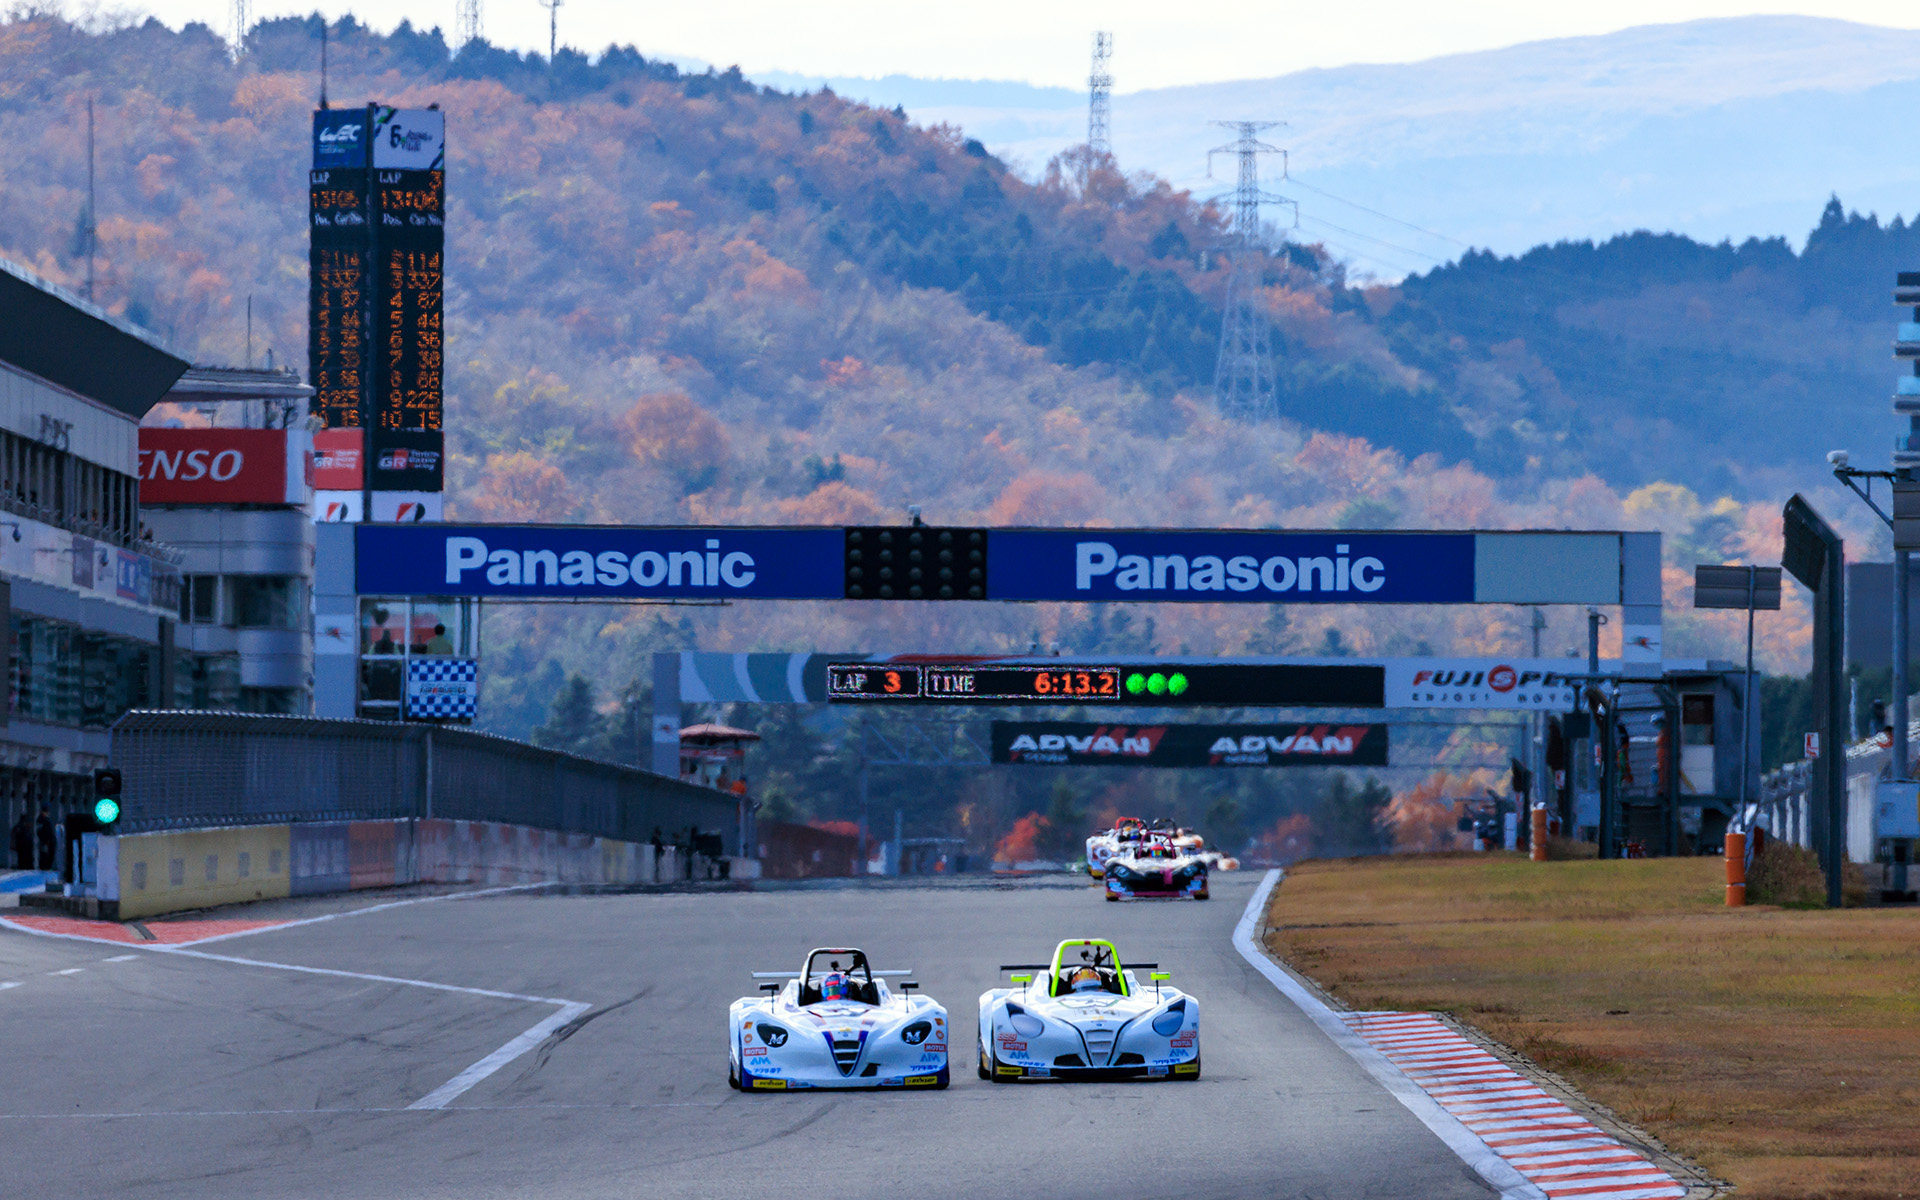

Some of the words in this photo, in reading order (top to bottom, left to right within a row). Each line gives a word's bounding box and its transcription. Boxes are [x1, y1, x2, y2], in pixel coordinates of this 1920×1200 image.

[390, 124, 401, 148] 6
[379, 171, 402, 183] LAP
[429, 171, 442, 190] 3
[390, 291, 402, 307] 4
[391, 311, 403, 328] 5
[418, 312, 440, 329] 44
[390, 330, 402, 348] 6
[390, 350, 402, 367] 7
[390, 390, 402, 408] 9
[406, 388, 440, 409] 225
[382, 411, 402, 427] 10
[419, 411, 440, 429] 15
[379, 457, 406, 470] GR
[446, 537, 755, 587] Panasonic
[1076, 542, 1385, 592] Panasonic
[833, 674, 867, 692] LAP
[884, 671, 901, 693] 3
[930, 674, 976, 693] TIME
[1034, 672, 1114, 694] 6:13.2
[1413, 670, 1485, 687] FUJI
[1009, 734, 1151, 754] ADVAN
[1208, 735, 1354, 755] ADVAN
